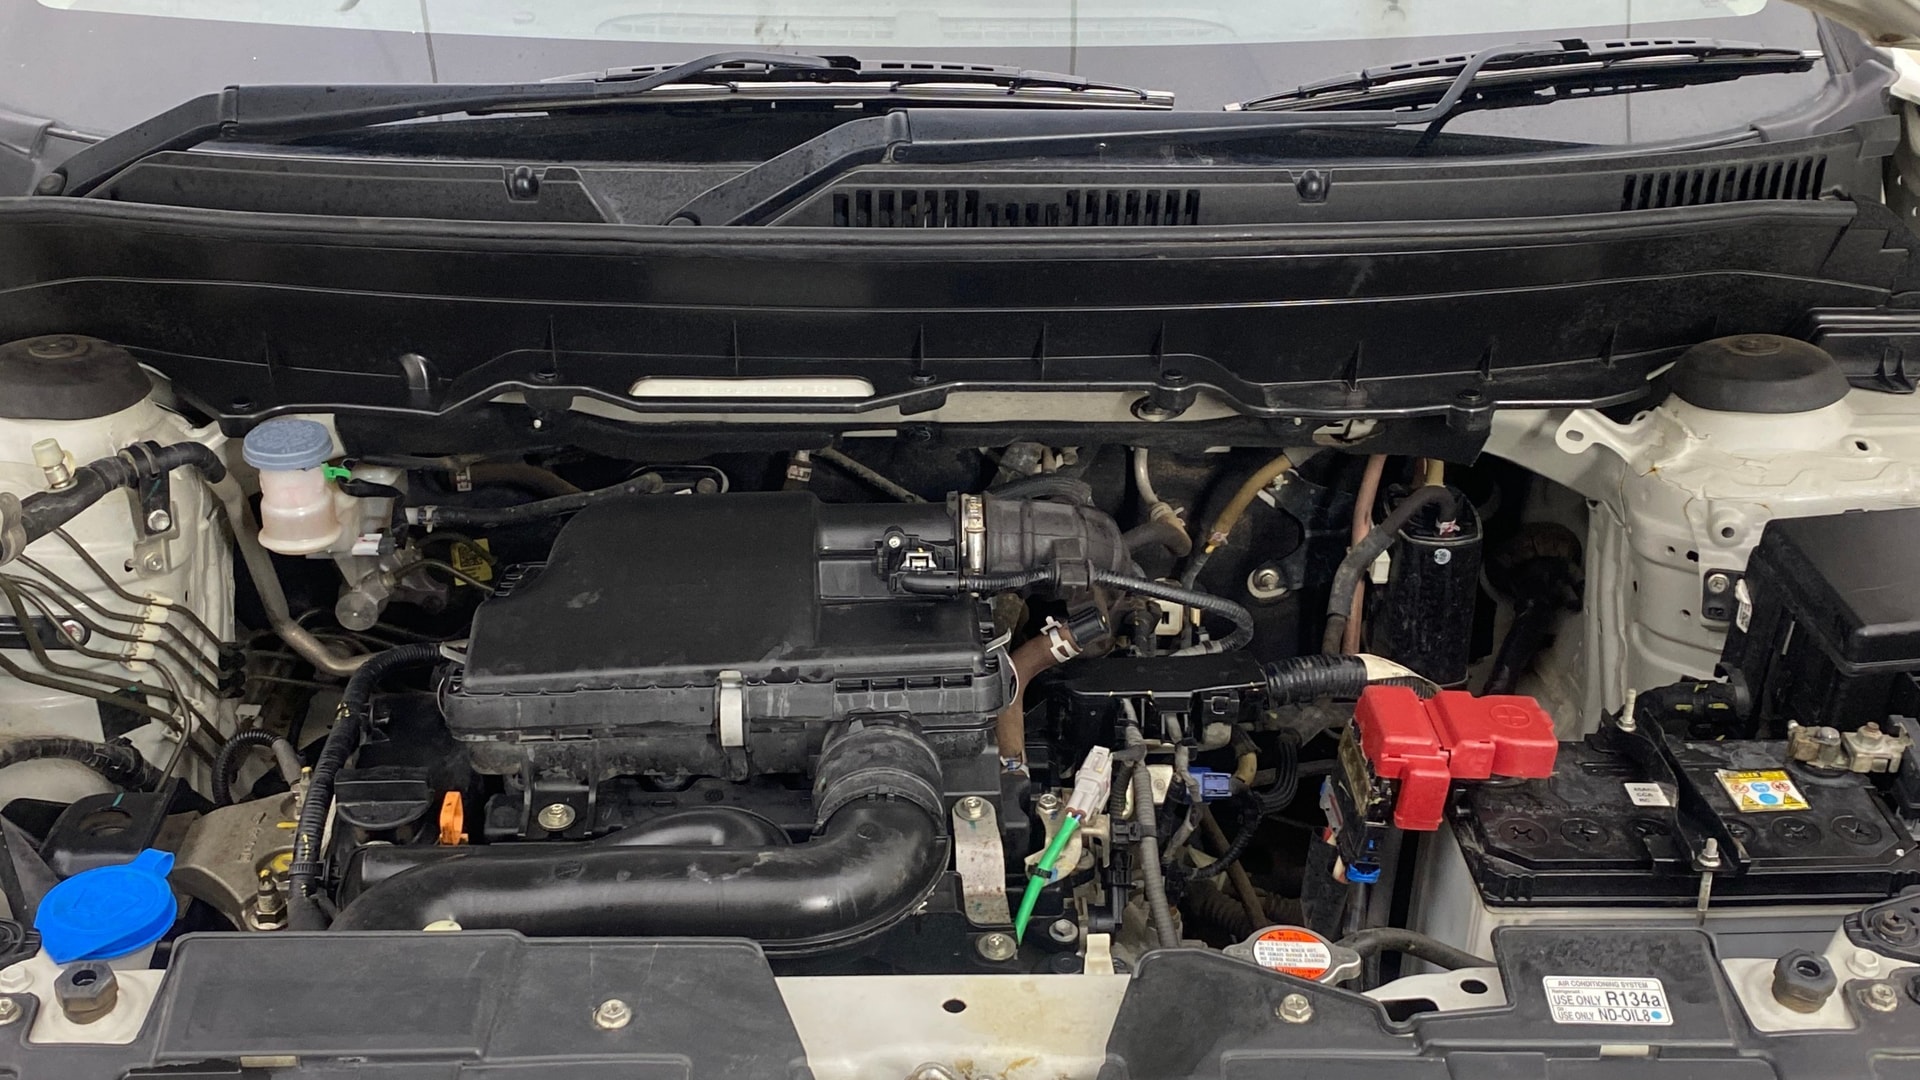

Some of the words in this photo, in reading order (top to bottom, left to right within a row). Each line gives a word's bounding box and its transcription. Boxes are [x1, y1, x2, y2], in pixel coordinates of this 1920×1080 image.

[1570, 980, 1619, 988] CONDITIONING
[1553, 995, 1575, 1005] USE
[1576, 995, 1601, 1005] ONLY
[1605, 991, 1661, 1007] R134a
[1558, 1010, 1574, 1020] USE
[1575, 1011, 1594, 1020] ONLY
[1598, 1008, 1650, 1022] ND-OIL8
